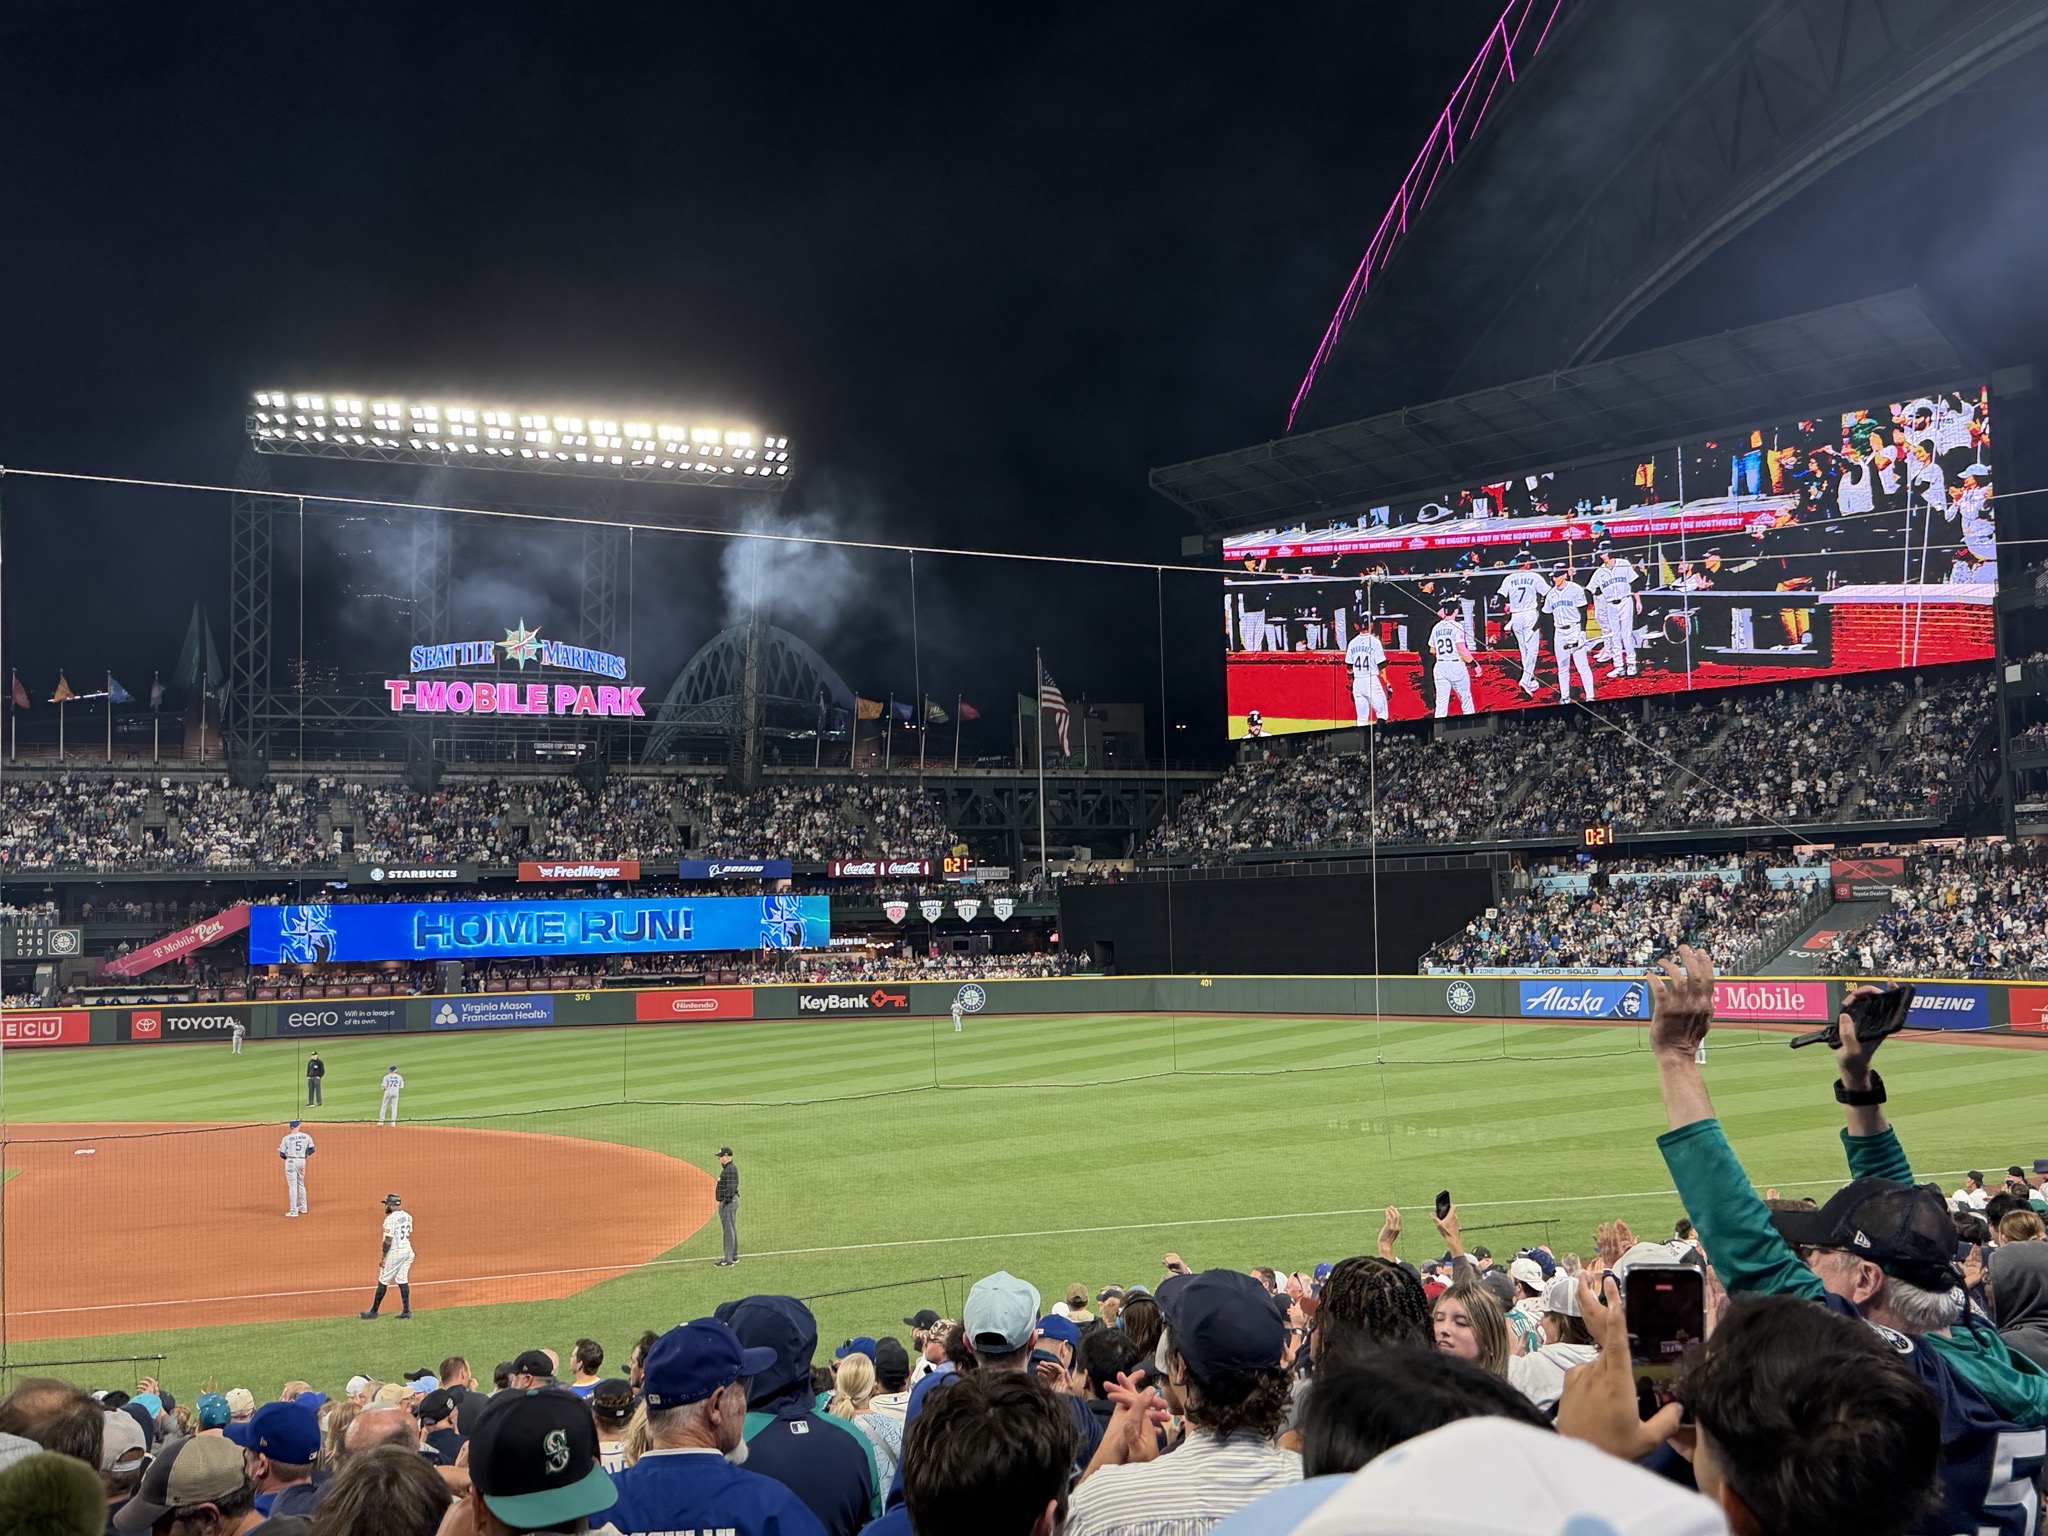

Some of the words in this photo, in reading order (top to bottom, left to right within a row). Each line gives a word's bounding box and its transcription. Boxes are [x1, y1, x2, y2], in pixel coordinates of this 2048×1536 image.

[1518, 587, 1526, 603] 7
[1437, 638, 1454, 655] 29
[410, 641, 494, 673] SEATTLE
[541, 640, 627, 679] MARINERS
[1354, 656, 1370, 671] 44
[384, 680, 549, 714] T-MOBILE
[555, 684, 646, 716] PARK
[1584, 827, 1614, 846] 0:21
[943, 858, 968, 873] 0:21
[388, 869, 458, 879] STARBUCKS
[890, 909, 902, 918] 42
[926, 908, 938, 917] 24
[963, 907, 972, 916] 11
[998, 906, 1009, 915] 51
[37, 928, 43, 936] E
[414, 910, 567, 949] HOME
[580, 908, 694, 943] RUN!
[17, 938, 23, 946] 2
[27, 938, 33, 946] 4
[37, 938, 43, 946] 0
[163, 935, 196, 954] Mobile
[1200, 978, 1213, 987] 401
[1845, 982, 1857, 992] 380
[575, 993, 591, 1001] 376
[800, 994, 869, 1012] KeyBank
[1527, 987, 1605, 1014] Alaska
[1726, 987, 1805, 1011] Mobile
[1910, 995, 1975, 1011] BOEING
[372, 1009, 395, 1017] league
[461, 1002, 498, 1014] Virginia
[500, 1001, 532, 1010] Mason
[676, 1001, 714, 1010] Nintendo
[167, 1016, 235, 1031] TOYOTA
[288, 1011, 339, 1027] eero
[461, 1013, 514, 1022] Franciscan
[515, 1010, 547, 1020] Health
[295, 1141, 302, 1151] 5
[400, 1225, 411, 1240] 53
